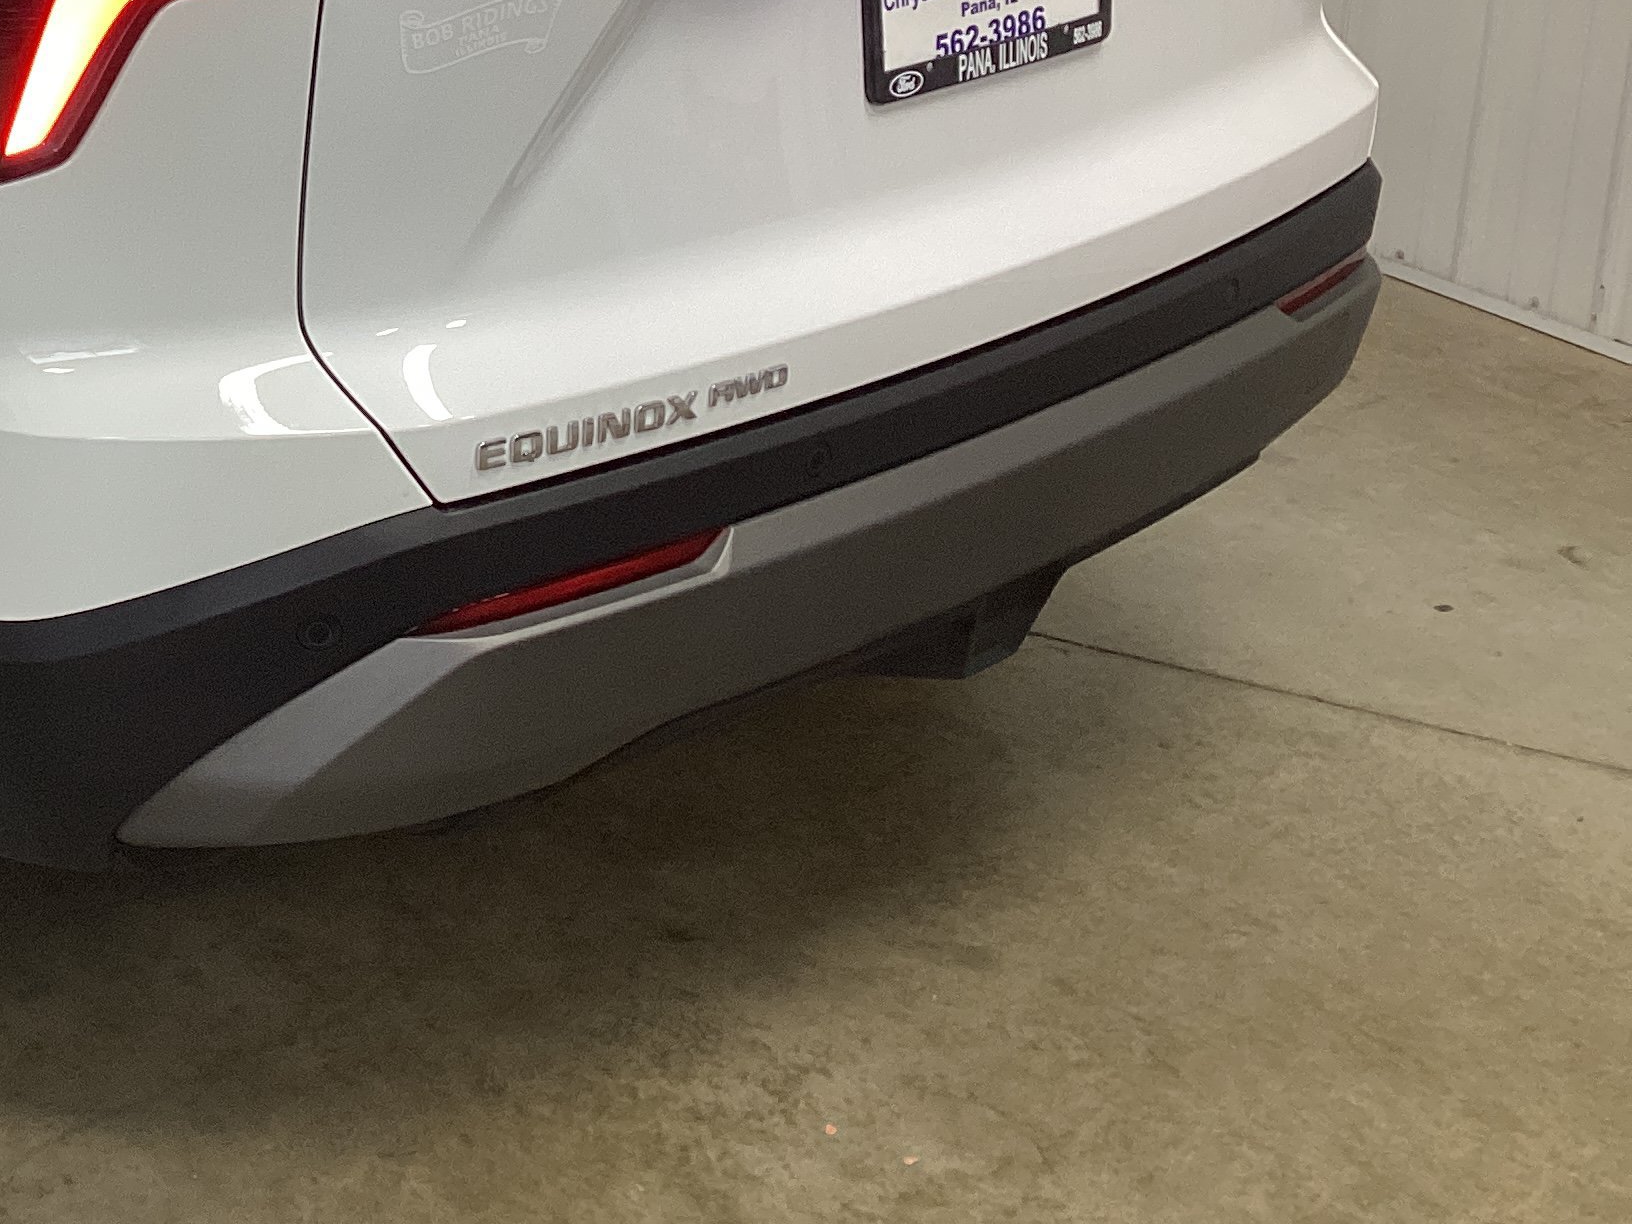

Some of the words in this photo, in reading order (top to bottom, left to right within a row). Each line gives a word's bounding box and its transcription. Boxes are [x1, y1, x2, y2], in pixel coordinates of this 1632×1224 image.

[961, 0, 1001, 18] Pana,
[411, 23, 454, 50] BOB
[935, 5, 1047, 60] 562-3986
[998, 31, 1049, 72] ILLINOIS
[475, 389, 698, 471] EQUINOX
[708, 362, 789, 408] AWD
